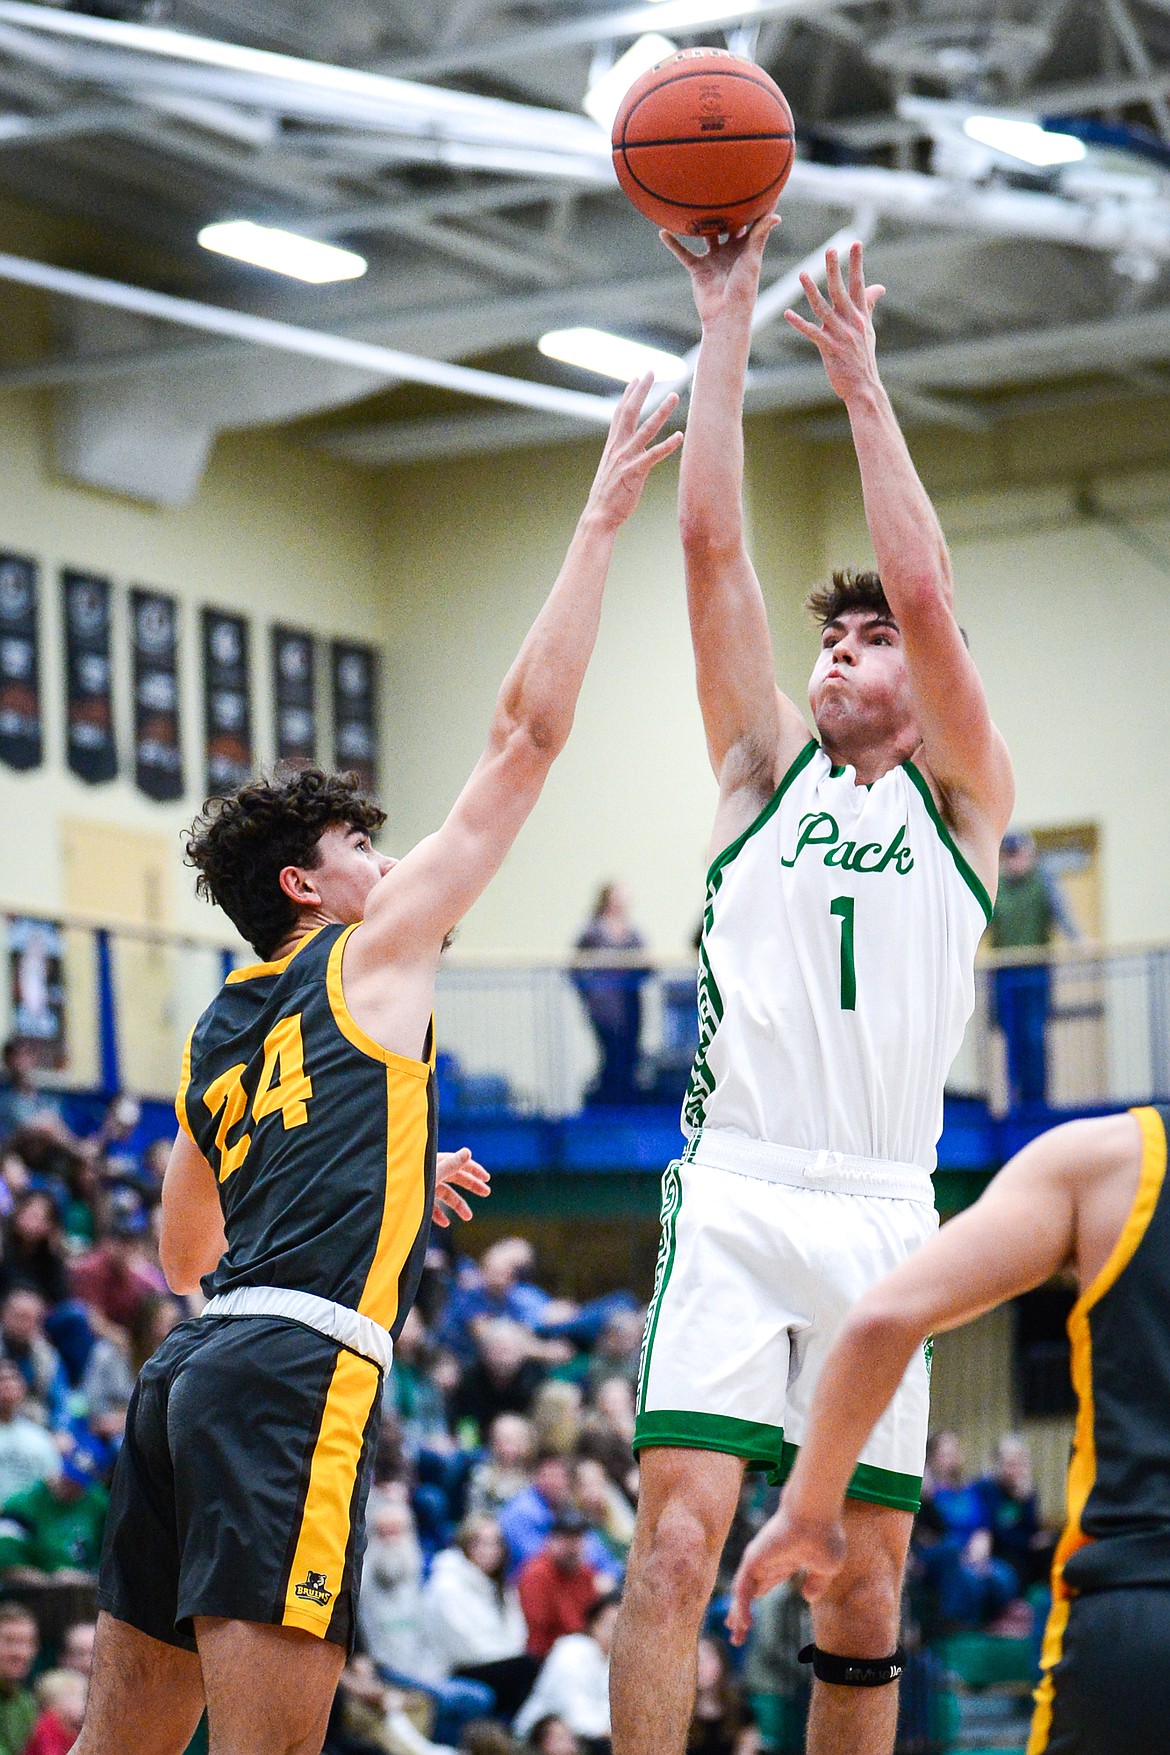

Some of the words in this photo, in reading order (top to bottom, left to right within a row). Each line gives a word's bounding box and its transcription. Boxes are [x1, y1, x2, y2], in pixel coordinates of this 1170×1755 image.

[781, 812, 914, 875] Pack
[830, 896, 856, 1011] 1
[202, 1012, 313, 1184] 24
[297, 1586, 330, 1603] BRUINS
